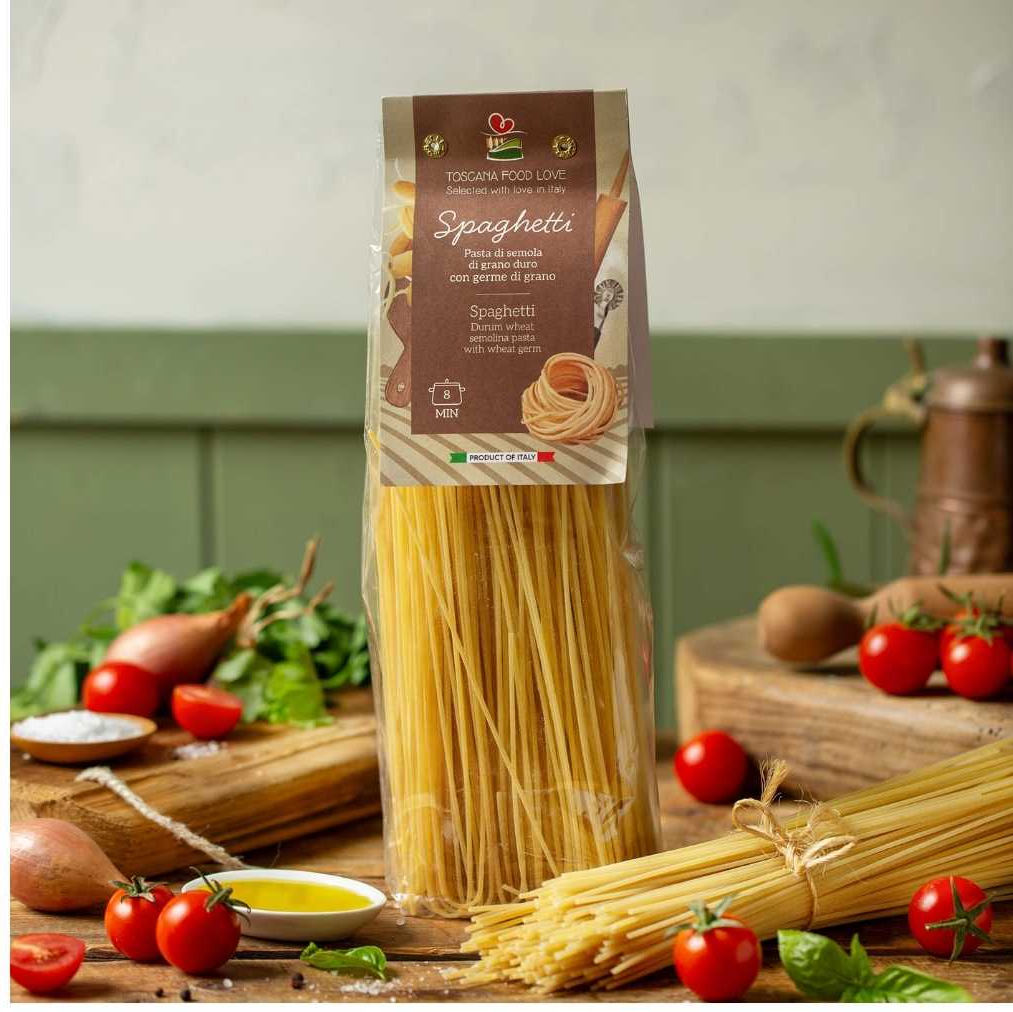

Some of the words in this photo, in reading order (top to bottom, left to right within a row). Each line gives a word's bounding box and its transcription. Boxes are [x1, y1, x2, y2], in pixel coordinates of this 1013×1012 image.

[446, 170, 498, 182] TOSCANA
[502, 170, 533, 181] FOOD
[536, 169, 567, 181] LOVE
[446, 185, 487, 195] Selected
[491, 185, 509, 195] with
[513, 185, 533, 194] love
[536, 185, 545, 193] in
[434, 208, 576, 246] Spaghetti
[464, 248, 491, 258] Pasta
[494, 248, 504, 258] di
[506, 248, 543, 257] semola
[468, 260, 478, 269] di
[481, 261, 510, 271] grano
[513, 259, 538, 269] duro
[449, 273, 470, 283] con
[472, 273, 508, 284] germe
[510, 272, 521, 281] di
[524, 272, 556, 283] grano
[469, 304, 535, 320] Spaghetti
[470, 322, 503, 331] Durum
[505, 322, 535, 331] wheat
[469, 333, 509, 343] semolina
[511, 334, 535, 344] pasta
[463, 344, 485, 354] with
[487, 344, 516, 353] wheat
[518, 345, 542, 355] germ
[443, 389, 451, 400] 8
[435, 408, 459, 419] MIN
[517, 453, 536, 461] ITALY
